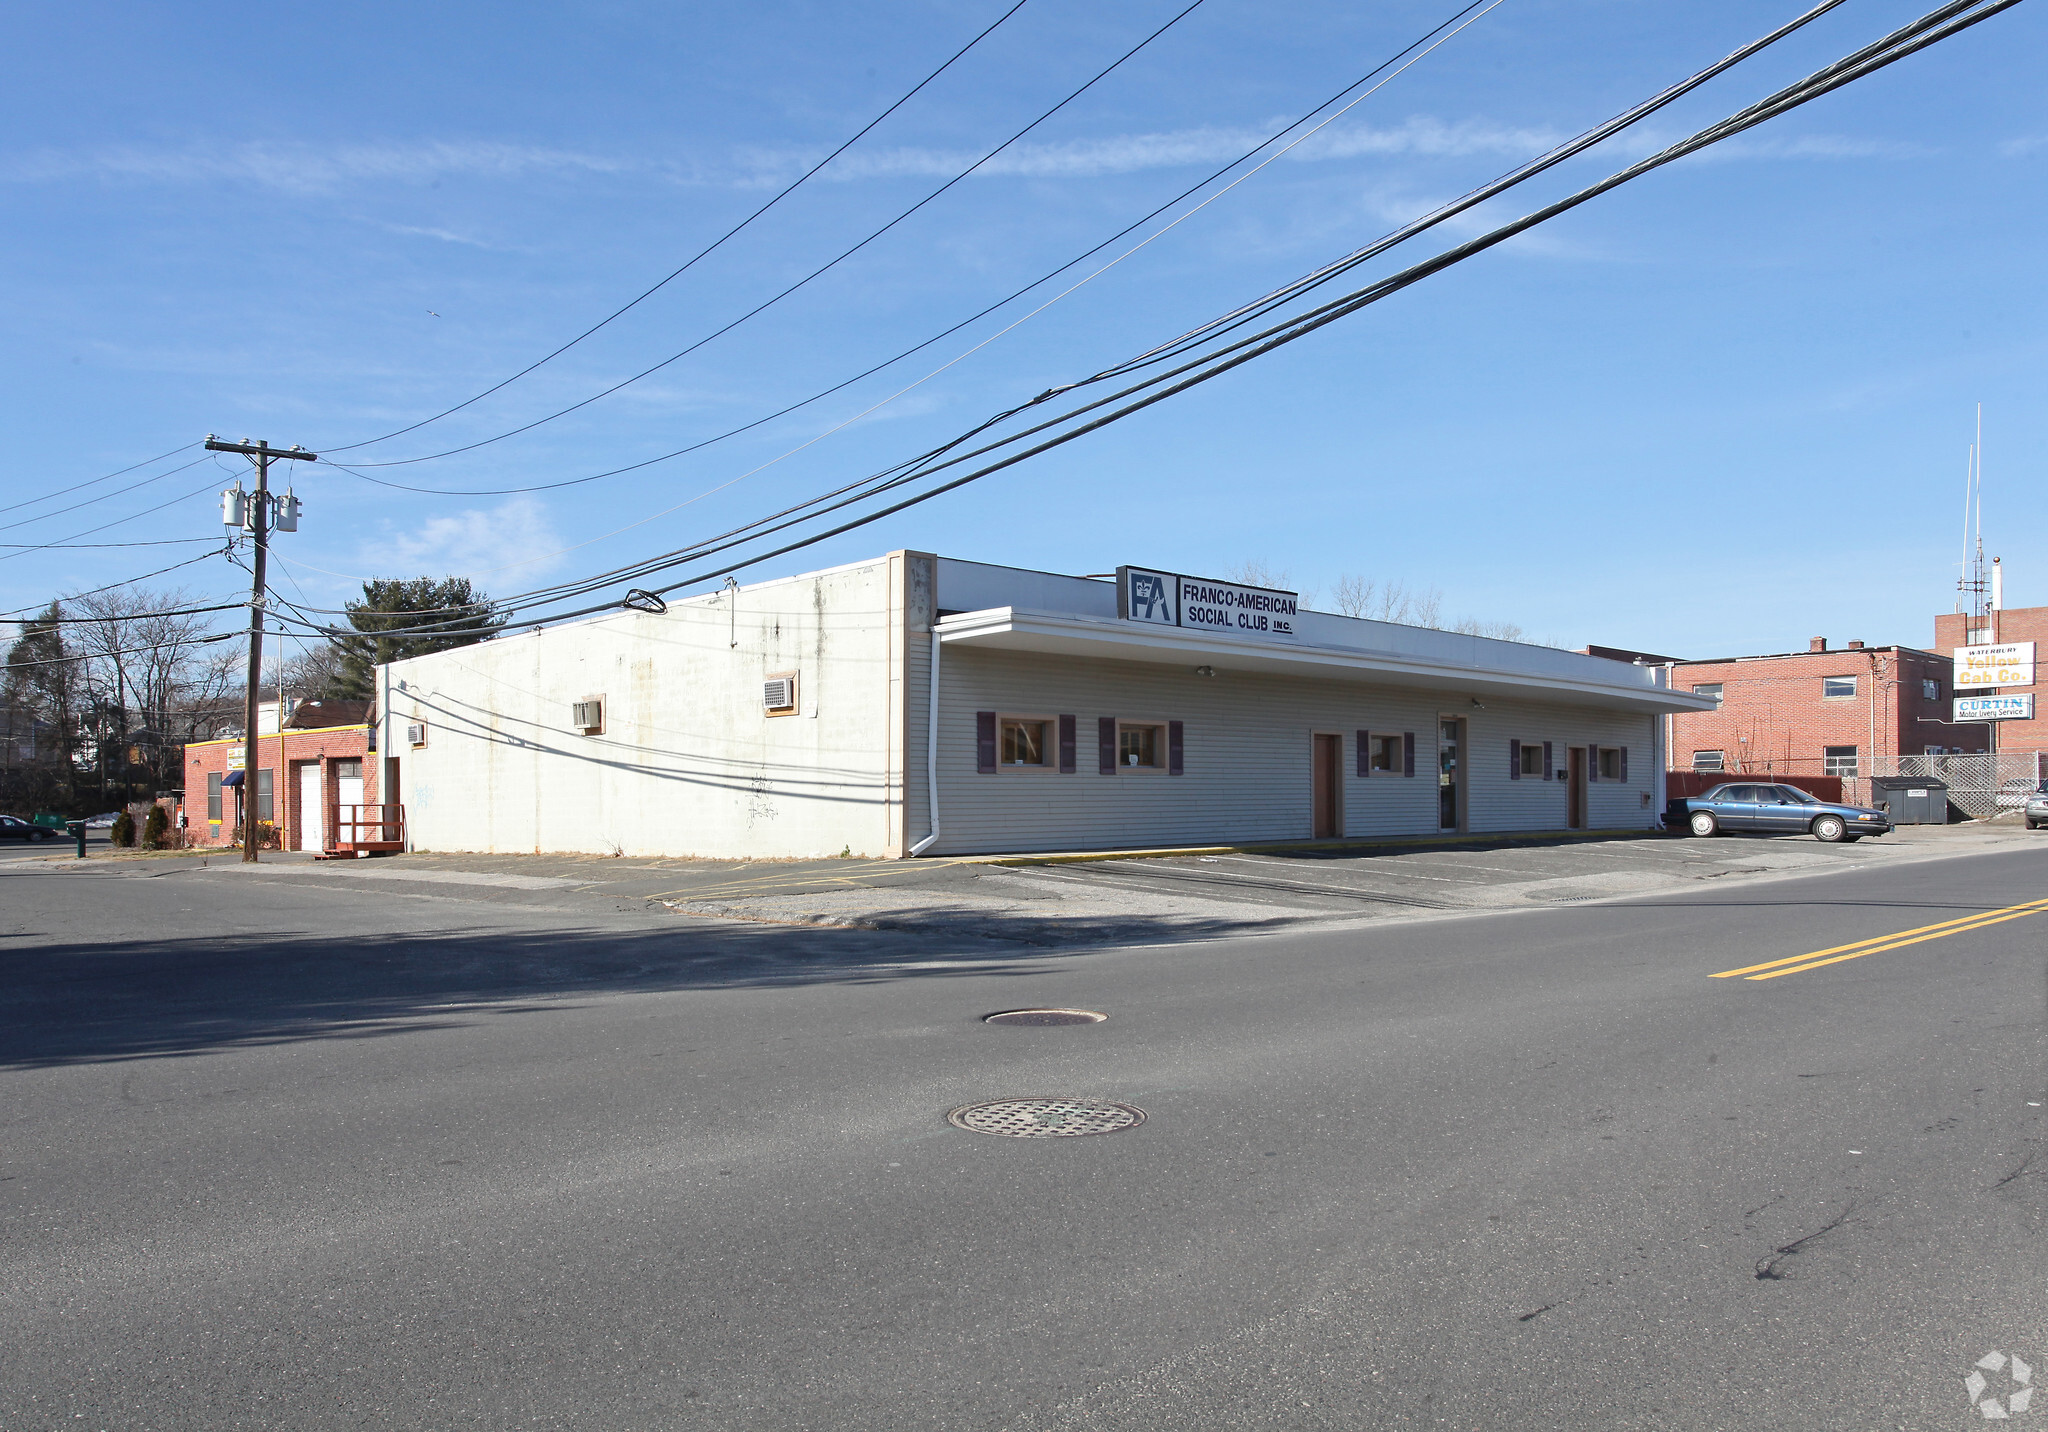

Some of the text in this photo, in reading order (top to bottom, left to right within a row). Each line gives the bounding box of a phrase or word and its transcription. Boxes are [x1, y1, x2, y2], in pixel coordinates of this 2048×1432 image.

[1183, 583, 1296, 616] FRANCO-AMERICAN
[1188, 606, 1292, 631] SOCIAL CLUB INC.
[1968, 647, 2017, 656] WATERBURY
[1966, 655, 2021, 670] Yellow
[1959, 669, 2027, 684] Cab Co.
[1959, 698, 2023, 711] CURTIN
[1959, 708, 2024, 718] Motor Livery Service
